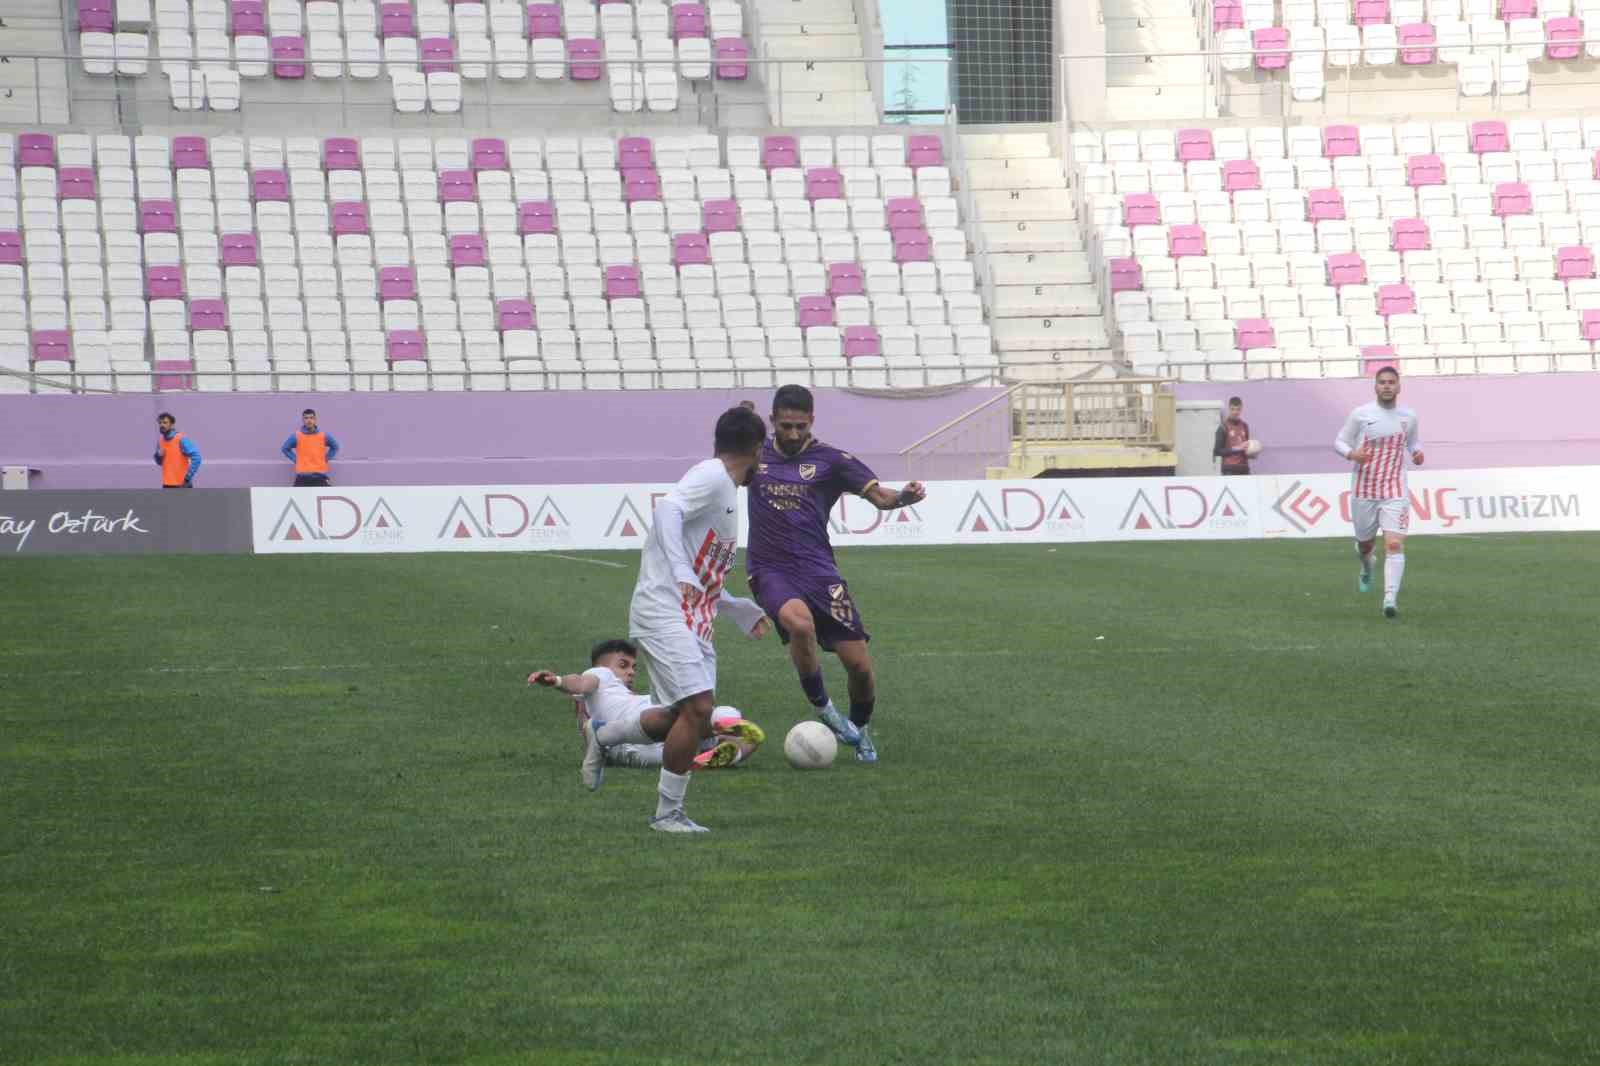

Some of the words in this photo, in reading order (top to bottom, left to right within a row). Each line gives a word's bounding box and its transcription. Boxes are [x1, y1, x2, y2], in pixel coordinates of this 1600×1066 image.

[1137, 18, 1144, 28] L
[800, 24, 808, 33] L
[1144, 55, 1153, 63] K
[806, 60, 815, 71] K
[5, 88, 12, 98] J
[1155, 87, 1161, 96] J
[816, 92, 823, 102] J
[1017, 222, 1026, 231] G
[1027, 254, 1035, 263] F
[1035, 287, 1042, 295] E
[1043, 320, 1051, 328] D
[1052, 352, 1061, 361] C
[956, 488, 1085, 532] ADA
[1119, 485, 1247, 529] ADA
[268, 495, 402, 541] ADA
[438, 494, 570, 538] ADA
[830, 492, 922, 534] DA
